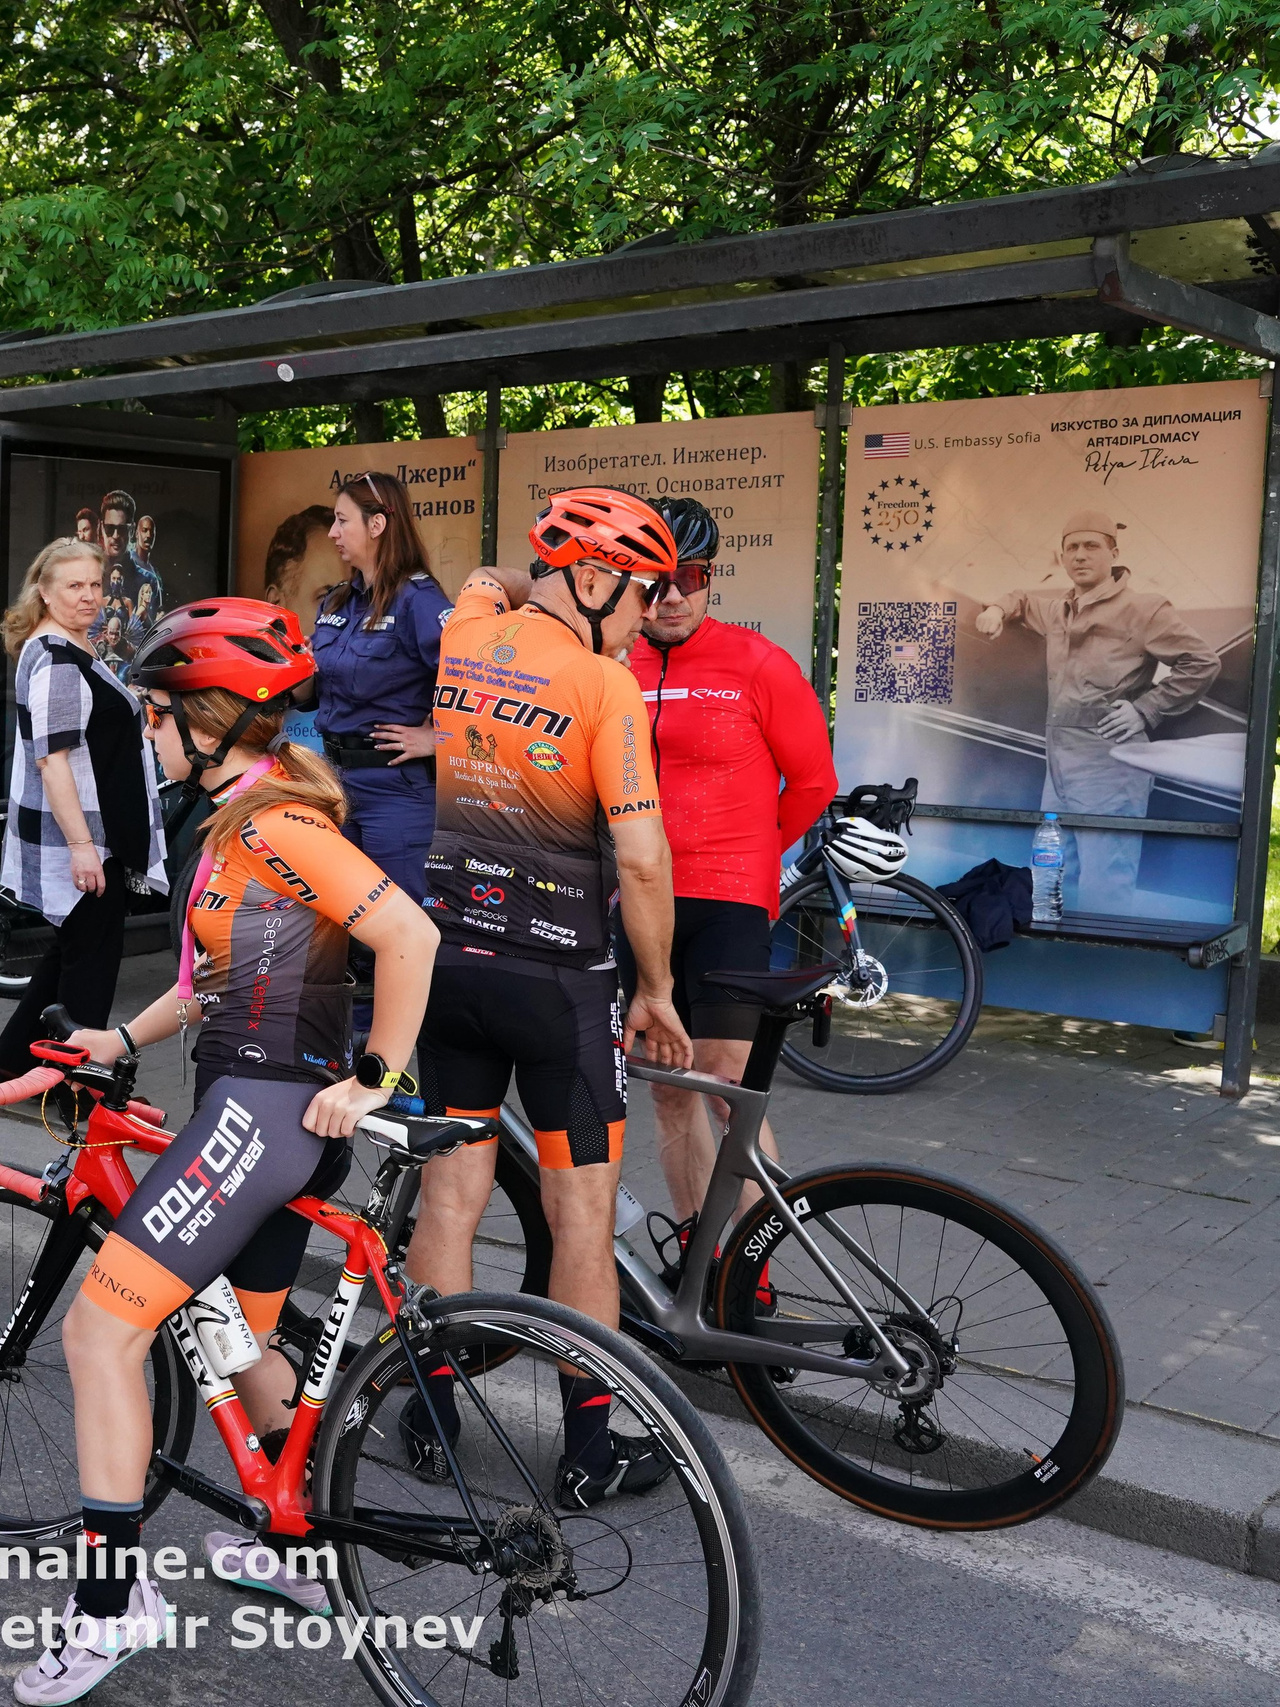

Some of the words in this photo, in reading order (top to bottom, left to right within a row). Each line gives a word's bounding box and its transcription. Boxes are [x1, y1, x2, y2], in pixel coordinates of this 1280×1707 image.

[1050, 418, 1118, 433] ИЗКУСТВО
[1122, 416, 1140, 428] ЗА
[1142, 409, 1242, 429] ДИПЛОМАЦИЯ
[913, 438, 939, 450] U.S.
[944, 433, 1003, 450] Embassy
[1007, 431, 1041, 445] Sofia
[1086, 430, 1201, 448] ART4DIPLOMACY
[544, 452, 666, 475] Изобретател.
[672, 445, 767, 467] Инженер.
[656, 472, 785, 495] Основателят
[412, 498, 476, 521] данов
[876, 500, 920, 510] Freedom
[876, 510, 920, 532] 250
[622, 714, 640, 796] eversocks
[449, 755, 468, 769] HOT
[470, 760, 522, 781] SPRINGS
[477, 776, 485, 785] &
[485, 776, 499, 788] Spa
[609, 799, 656, 817] DANI
[239, 818, 320, 905] LTCINI
[464, 906, 508, 923] eversocks
[529, 926, 578, 948] SOFIA
[530, 917, 577, 938] HERA
[141, 1097, 254, 1244] DOLTCINI
[744, 1214, 784, 1262] SWISS
[220, 1283, 243, 1320] RYSEL
[239, 1325, 253, 1349] VAN
[308, 1288, 351, 1388] RIDLEY
[170, 1311, 215, 1389] DLEY
[1033, 1468, 1043, 1479] DT
[197, 1484, 239, 1510] ULTEGRA
